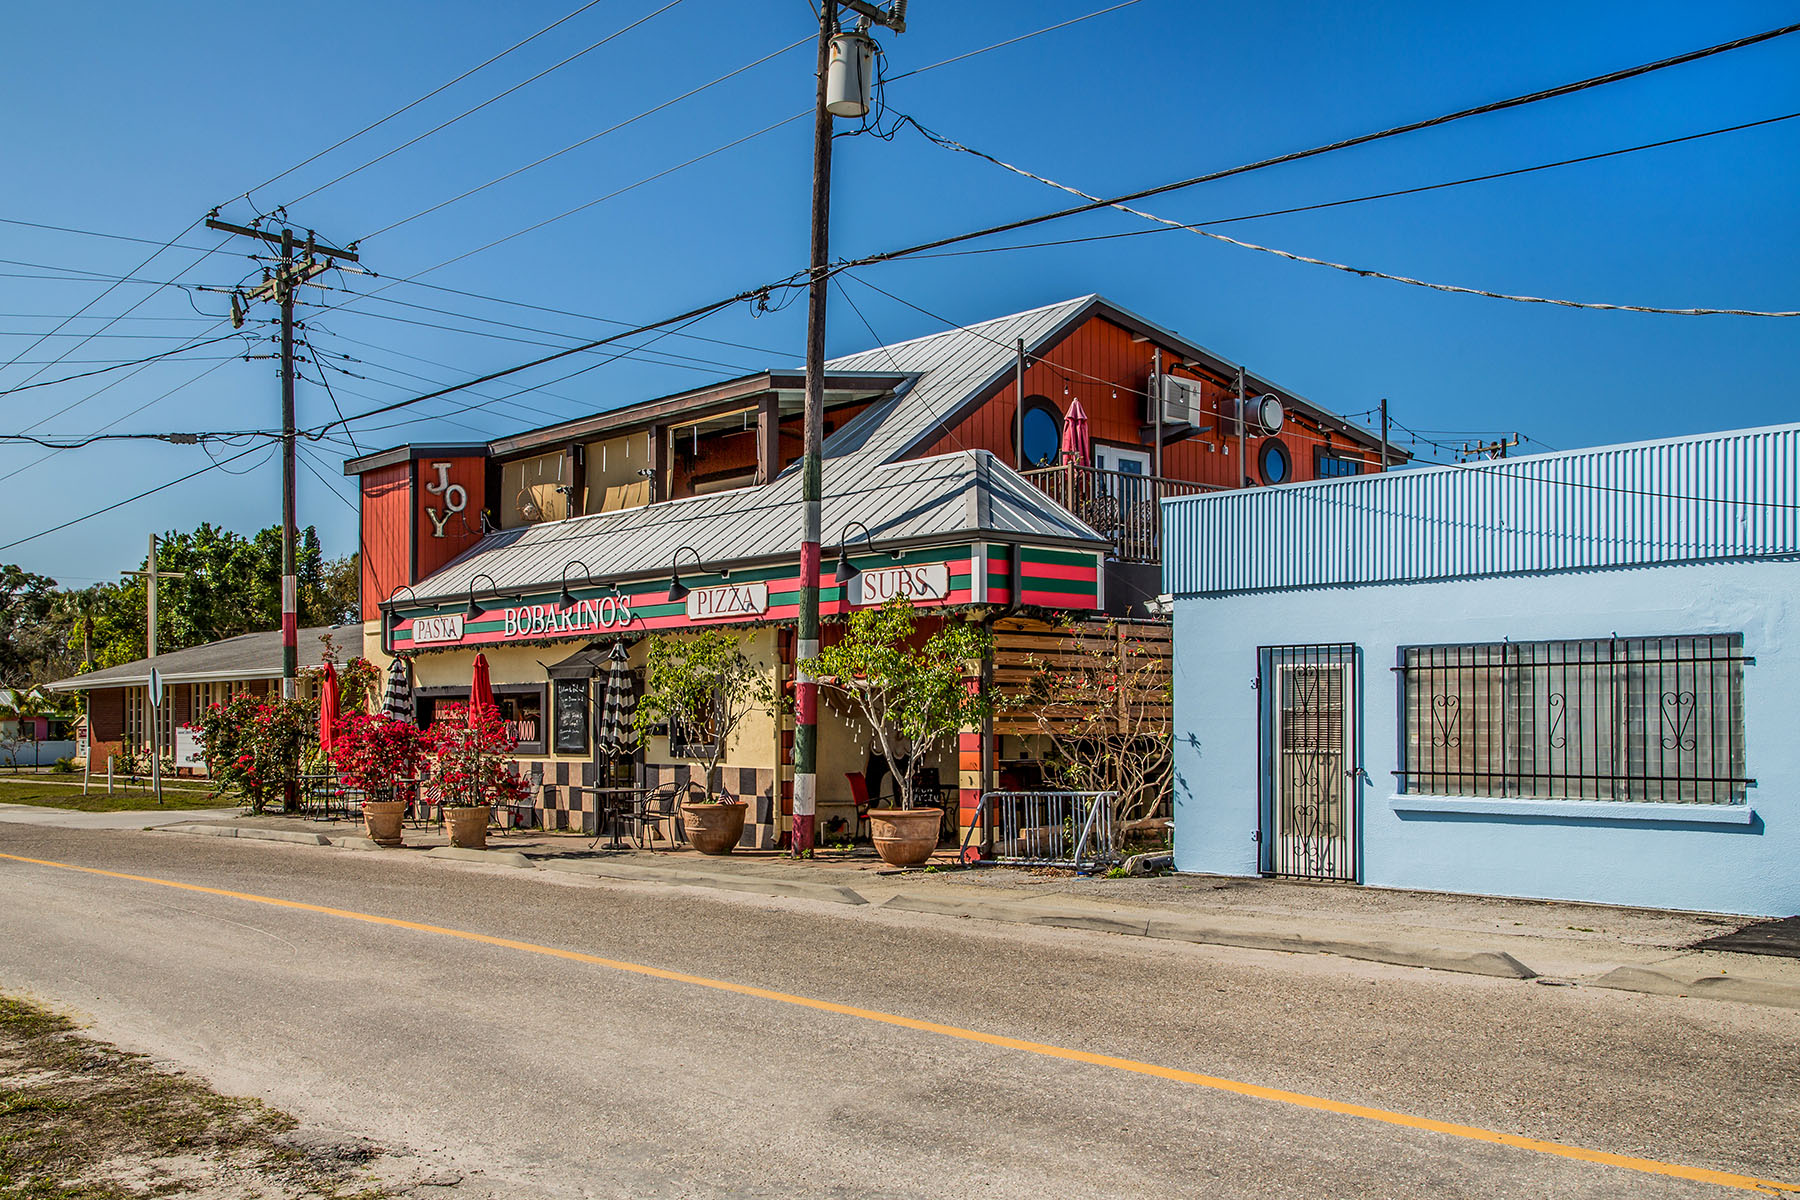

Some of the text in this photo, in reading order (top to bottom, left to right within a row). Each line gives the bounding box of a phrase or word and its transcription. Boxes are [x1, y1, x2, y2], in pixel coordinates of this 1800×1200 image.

[864, 567, 928, 600] SUBS
[503, 593, 632, 637] BOBARINO'S
[697, 587, 752, 615] PIZZA
[418, 618, 457, 640] PASTA
